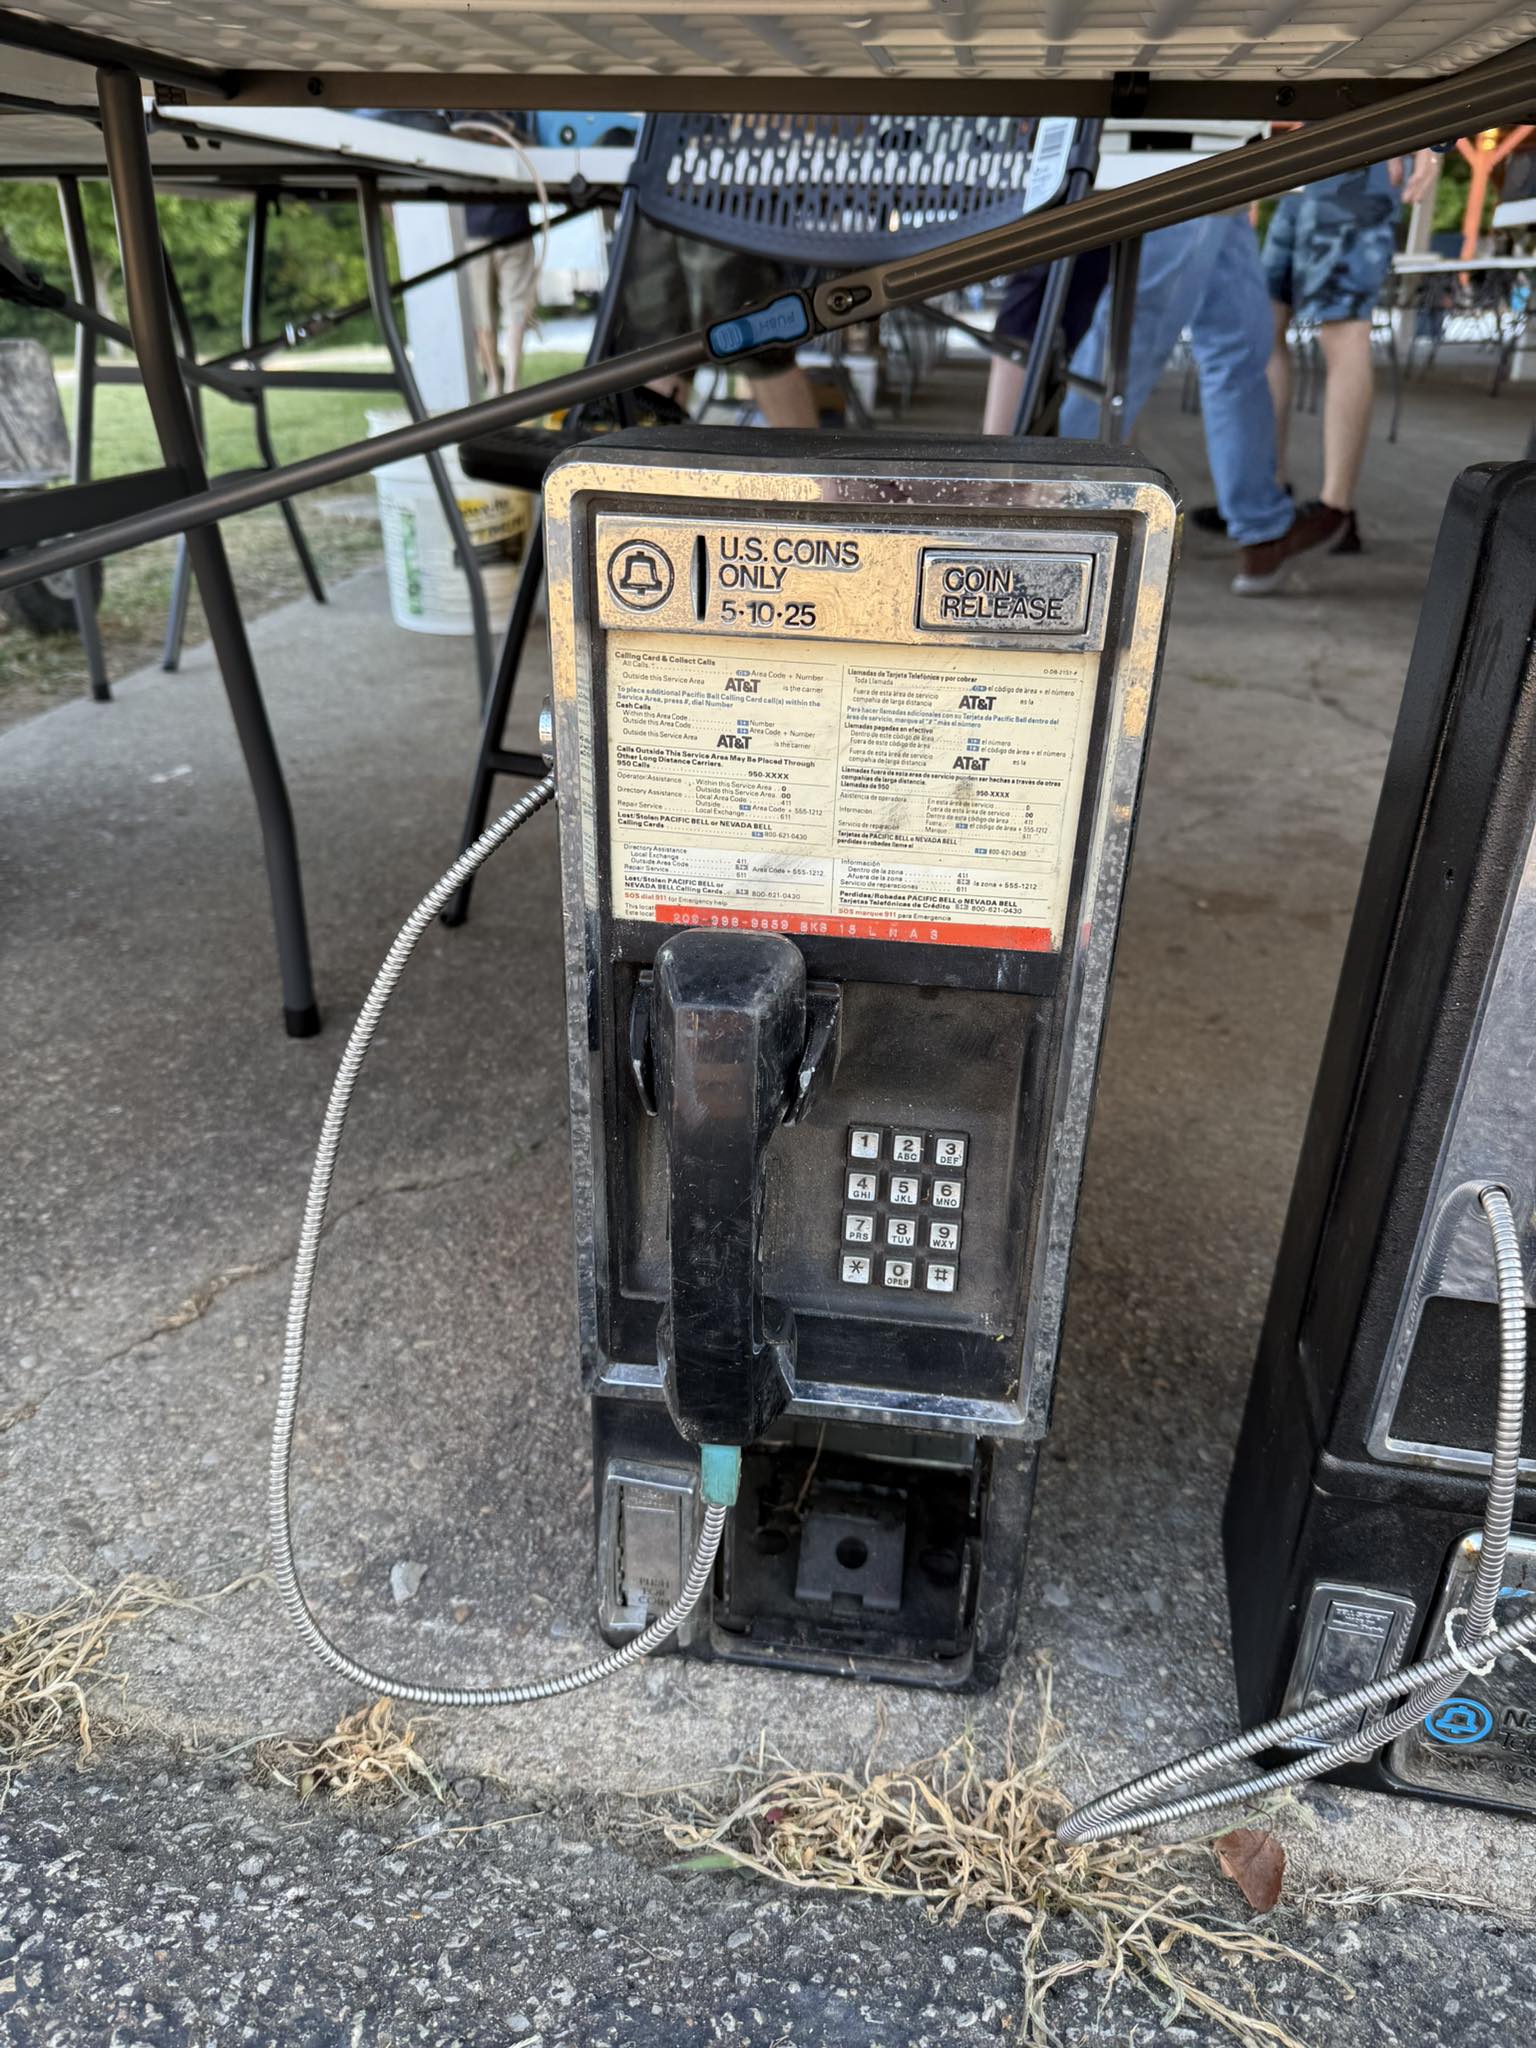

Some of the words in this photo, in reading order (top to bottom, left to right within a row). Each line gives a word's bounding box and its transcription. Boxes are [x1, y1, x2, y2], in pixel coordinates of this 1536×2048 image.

[720, 536, 767, 564] U.S.
[773, 539, 860, 568] COINS
[719, 563, 788, 591] ONLY
[942, 568, 1013, 594] COIN
[941, 596, 1065, 620] RELEASE
[615, 651, 640, 660] Calling
[642, 653, 659, 661] Card
[669, 656, 695, 664] Collect
[622, 672, 648, 680] Outside
[663, 675, 687, 683] Service
[724, 677, 761, 693] AT&T
[958, 694, 996, 710] AT&T
[717, 734, 751, 749] AT&T
[616, 752, 637, 760] Other
[658, 756, 690, 764] Distance
[635, 746, 664, 754] Outside
[682, 750, 709, 758] Service
[757, 756, 782, 764] Placed
[783, 758, 815, 766] Through
[952, 755, 990, 771] AT&T
[748, 770, 789, 779] 950-XXXX
[976, 790, 1009, 798] 950-XXXX
[660, 815, 689, 823] PACIFIC
[719, 820, 752, 828] NEVADA
[907, 894, 937, 902] PACIFIC
[964, 898, 997, 906] NEVADA
[909, 927, 919, 938] A
[860, 1135, 868, 1147] 1
[904, 1139, 914, 1152] 2
[945, 1143, 956, 1155] 3
[897, 1152, 917, 1161] ABC
[940, 1156, 959, 1164] DEF
[856, 1177, 867, 1189] 4
[899, 1181, 909, 1193] 5
[853, 1191, 871, 1199] GHI
[941, 1185, 952, 1197] 6
[894, 1195, 913, 1203] JKL
[936, 1198, 957, 1207] MNO
[855, 1219, 866, 1231] 7
[896, 1223, 908, 1235] 8
[849, 1232, 869, 1241] PRS
[939, 1227, 950, 1239] 9
[891, 1235, 911, 1244] TUV
[933, 1239, 954, 1248] WXY
